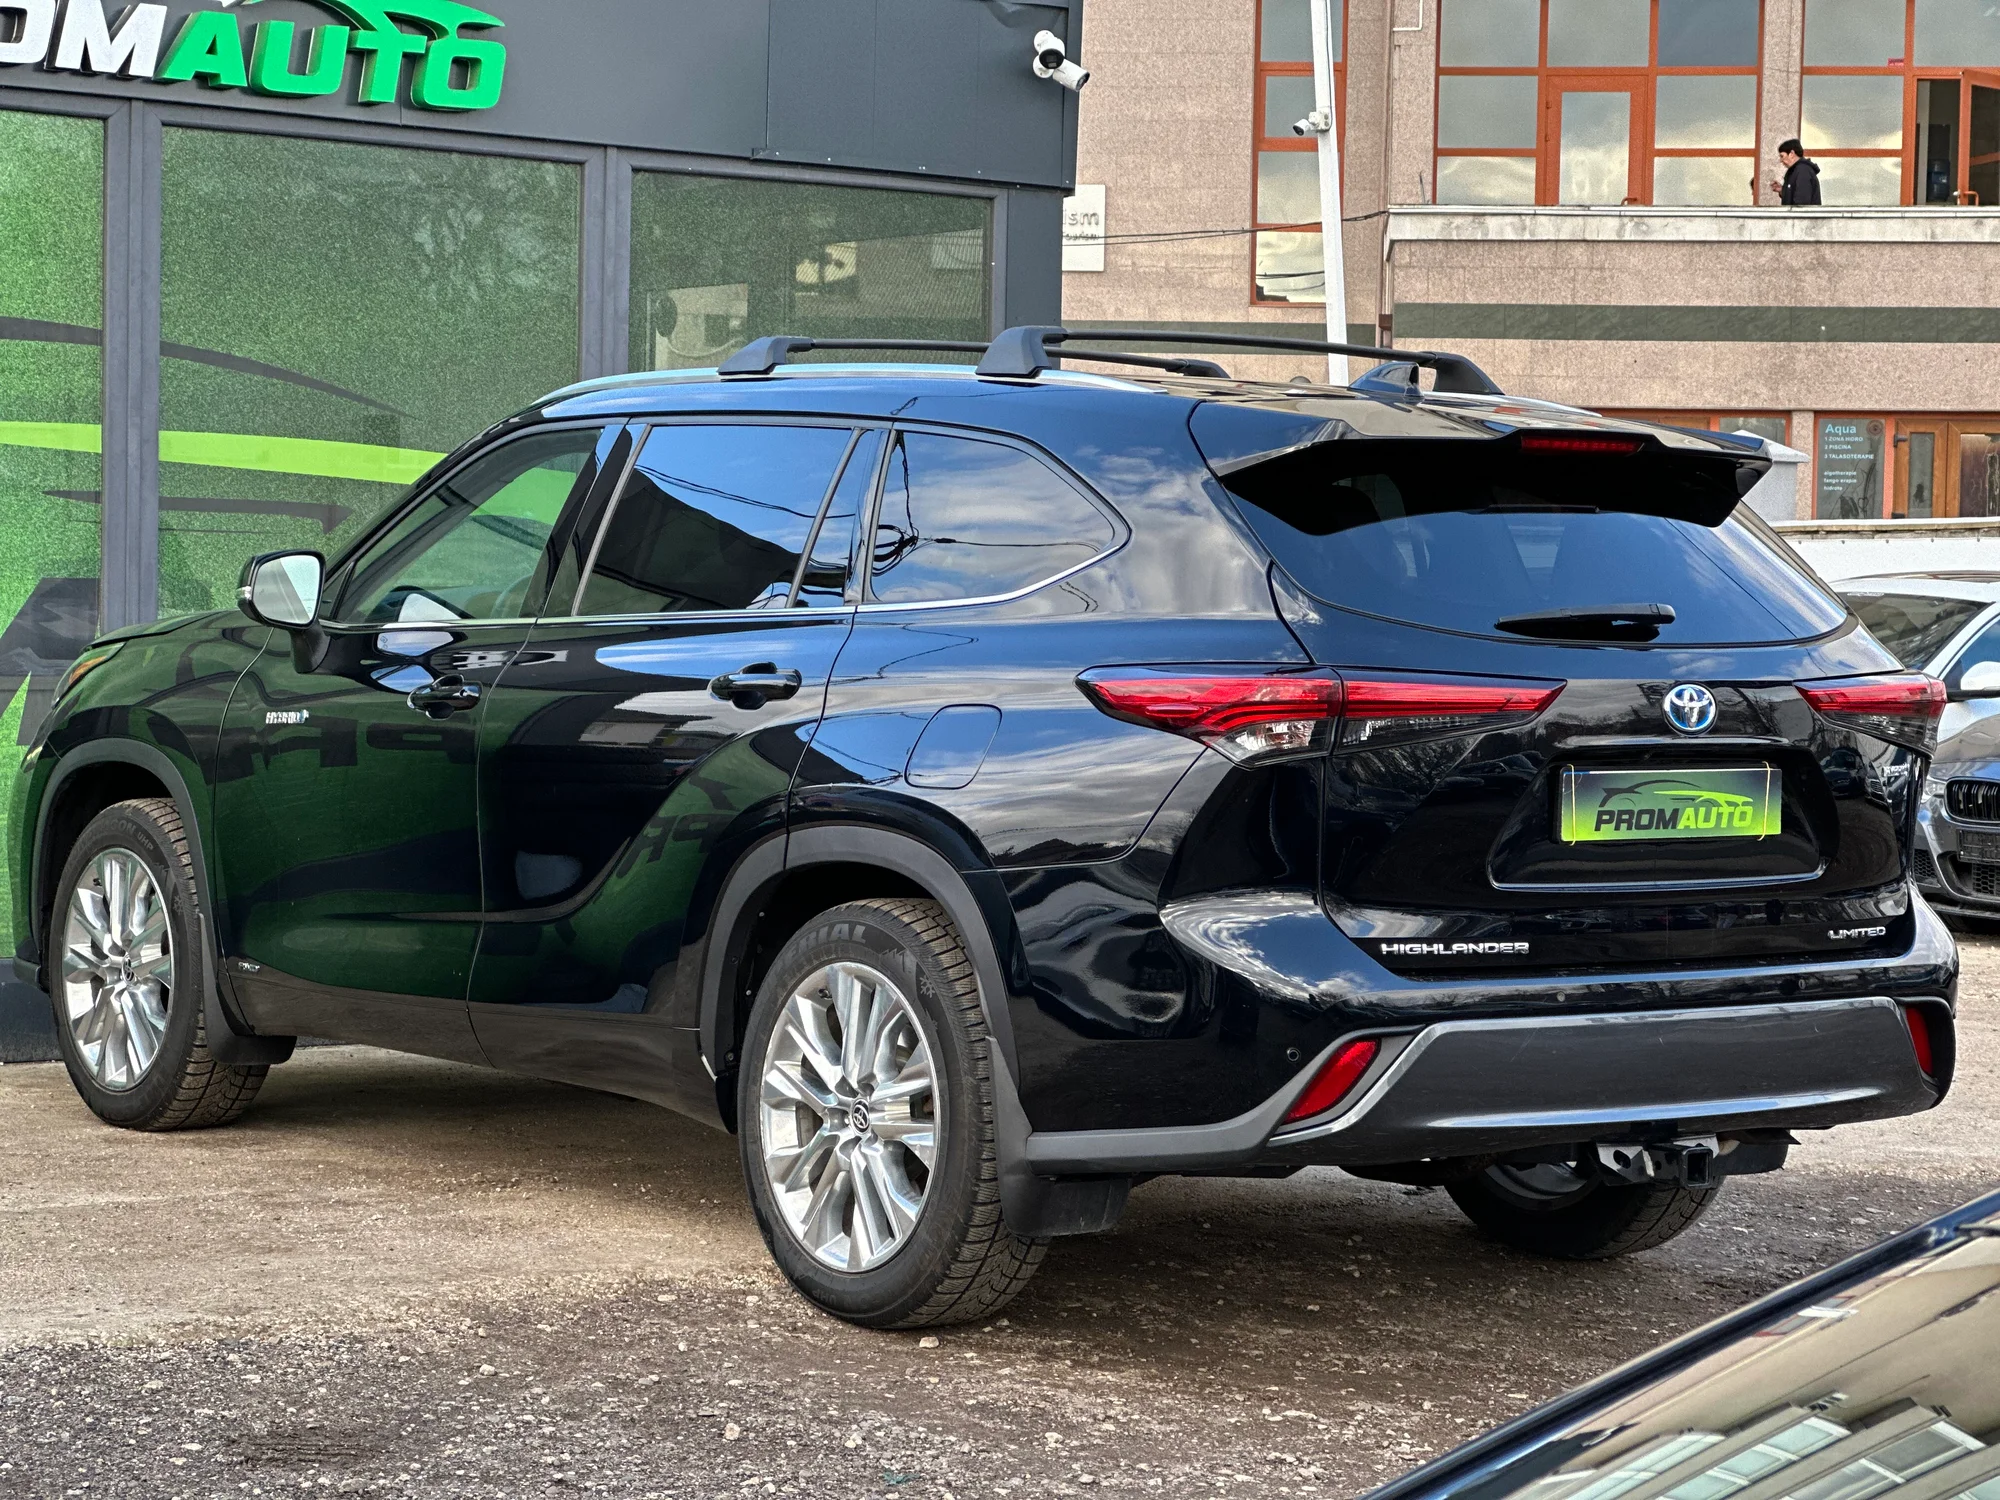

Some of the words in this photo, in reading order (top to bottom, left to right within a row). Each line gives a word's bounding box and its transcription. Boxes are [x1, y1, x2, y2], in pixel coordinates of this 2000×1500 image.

[1825, 424, 1857, 435] Aqua
[1594, 805, 1754, 832] PROMAUTO
[1827, 926, 1887, 940] LIMITED
[1381, 942, 1530, 955] HIGHLANDER
